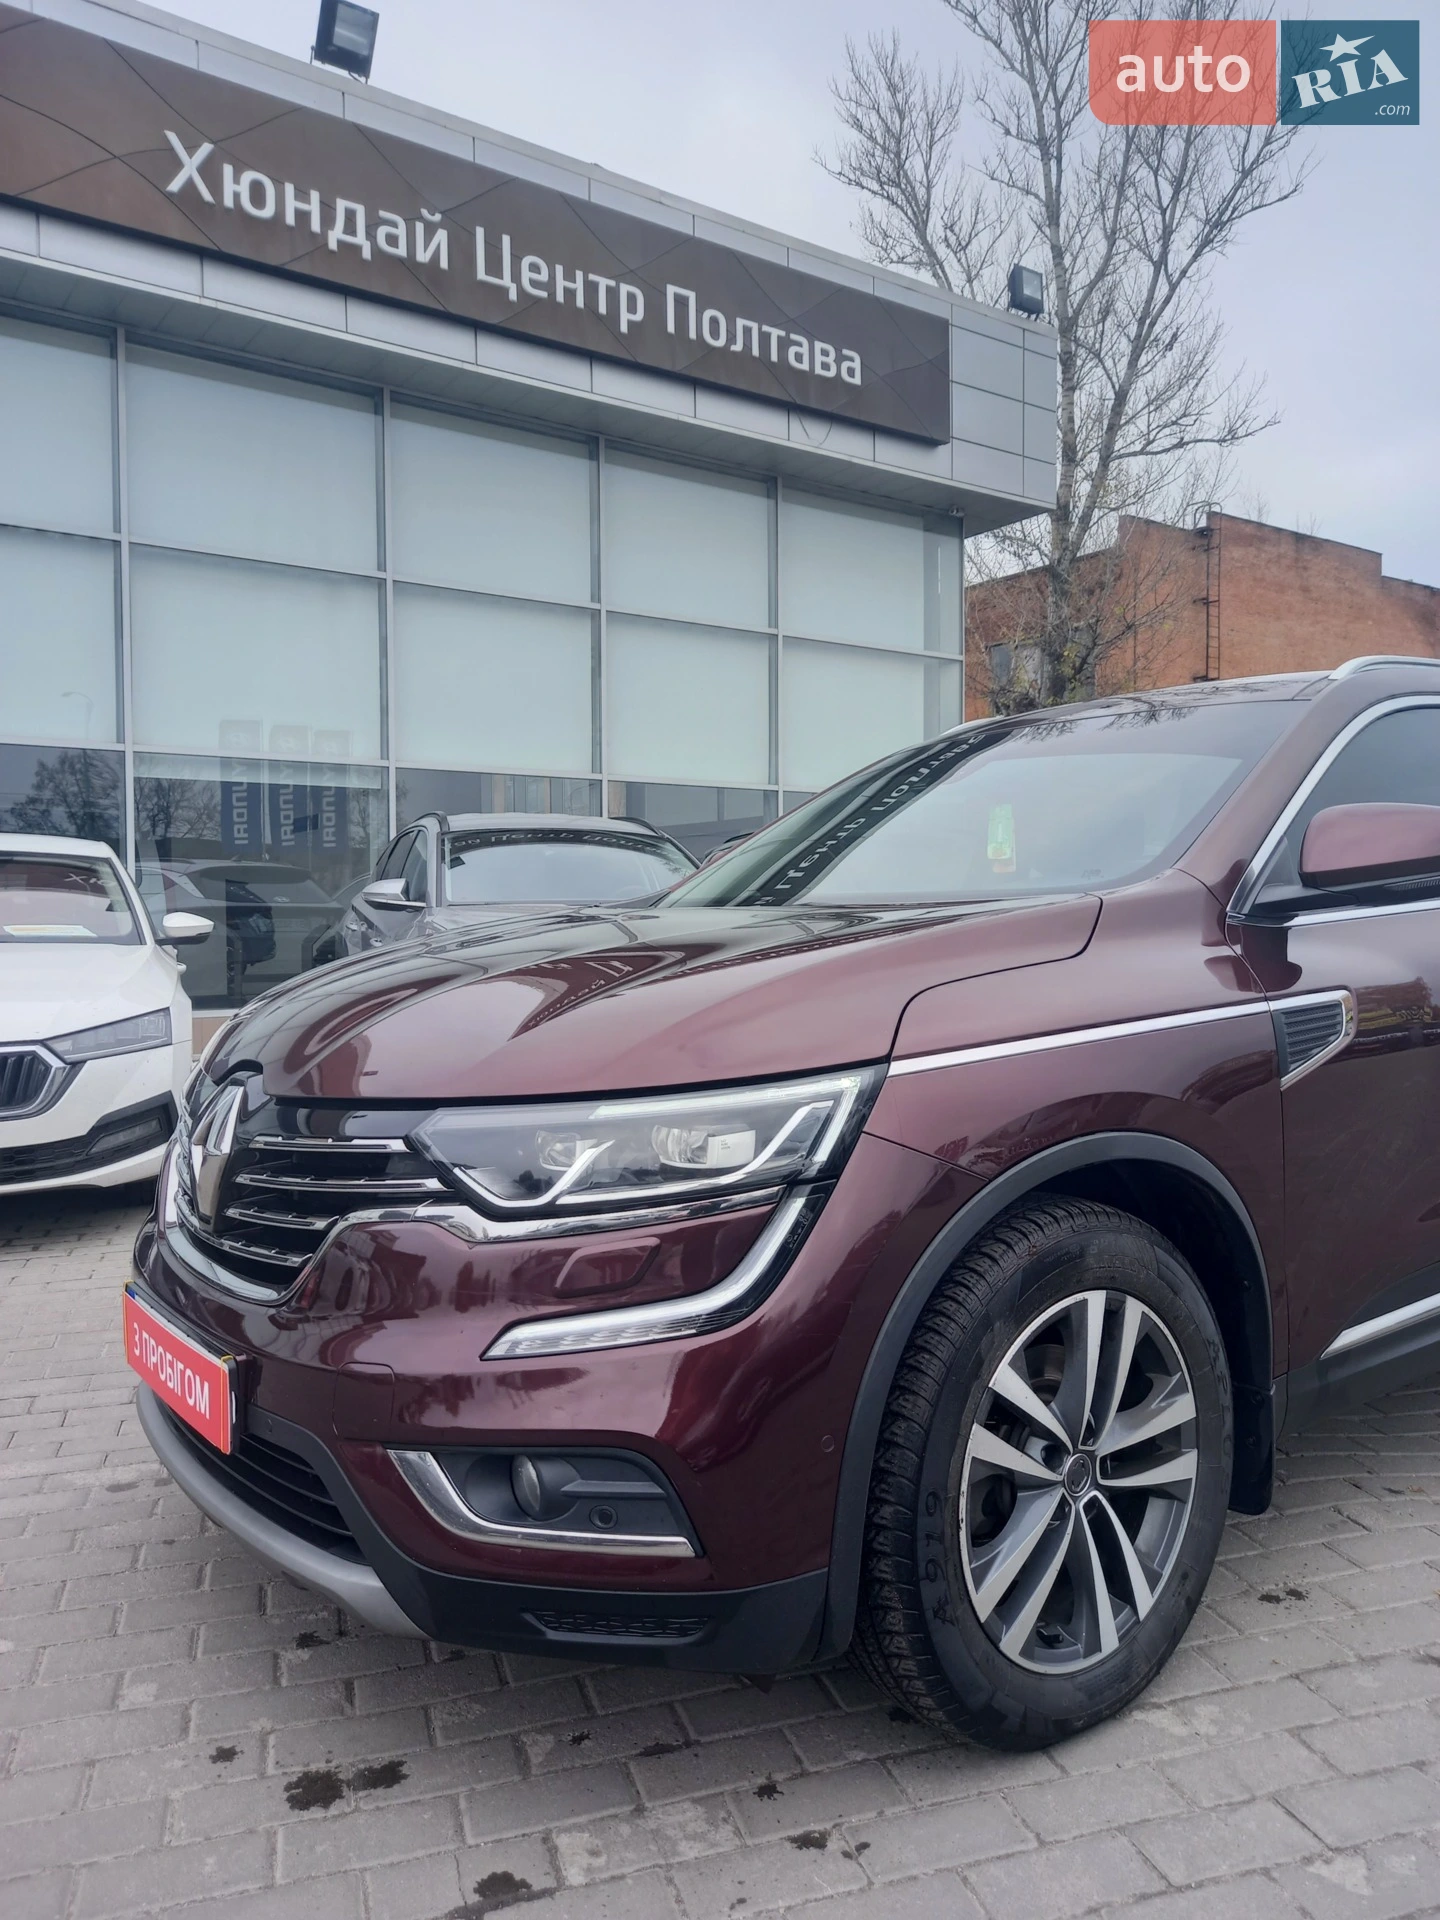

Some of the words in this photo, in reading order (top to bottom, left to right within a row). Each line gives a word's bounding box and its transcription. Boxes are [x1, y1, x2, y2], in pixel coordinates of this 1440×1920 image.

[164, 130, 451, 271] Хюндай
[475, 225, 645, 334] Центр
[665, 283, 863, 386] Полтава
[142, 1330, 210, 1420] ПРОБІГОМ
